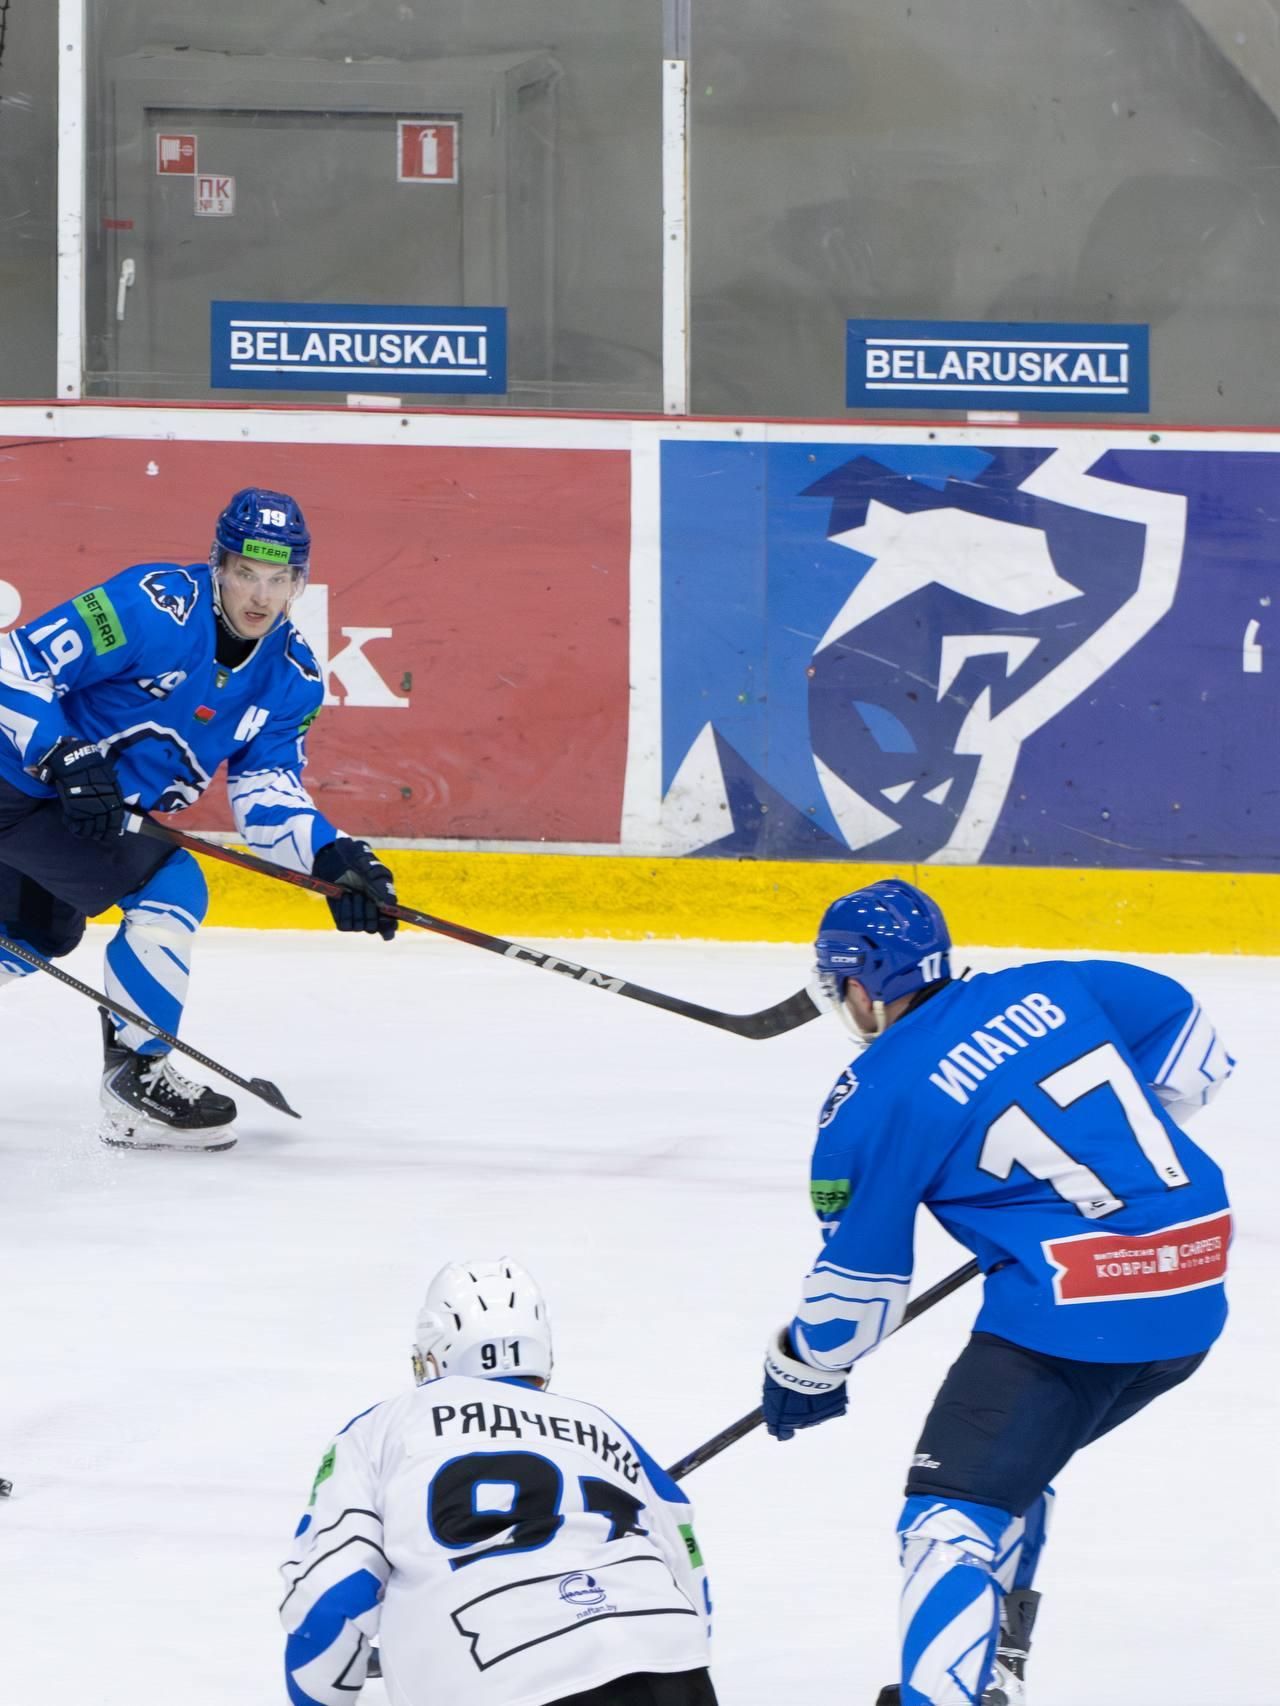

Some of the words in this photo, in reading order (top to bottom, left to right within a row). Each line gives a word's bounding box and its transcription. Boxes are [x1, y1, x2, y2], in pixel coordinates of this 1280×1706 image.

[199, 178, 230, 199] ПК
[230, 331, 487, 365] BELARUSKALI
[865, 349, 1129, 383] BELARUSKALI
[258, 508, 287, 527] 19
[27, 616, 84, 677] 19
[504, 943, 627, 994] CCM
[917, 951, 943, 983] 17
[928, 992, 1067, 1105] ИПАТОВ
[976, 1039, 1193, 1220] 17
[1095, 1260, 1157, 1278] КОВРЫ
[480, 1340, 521, 1370] 91
